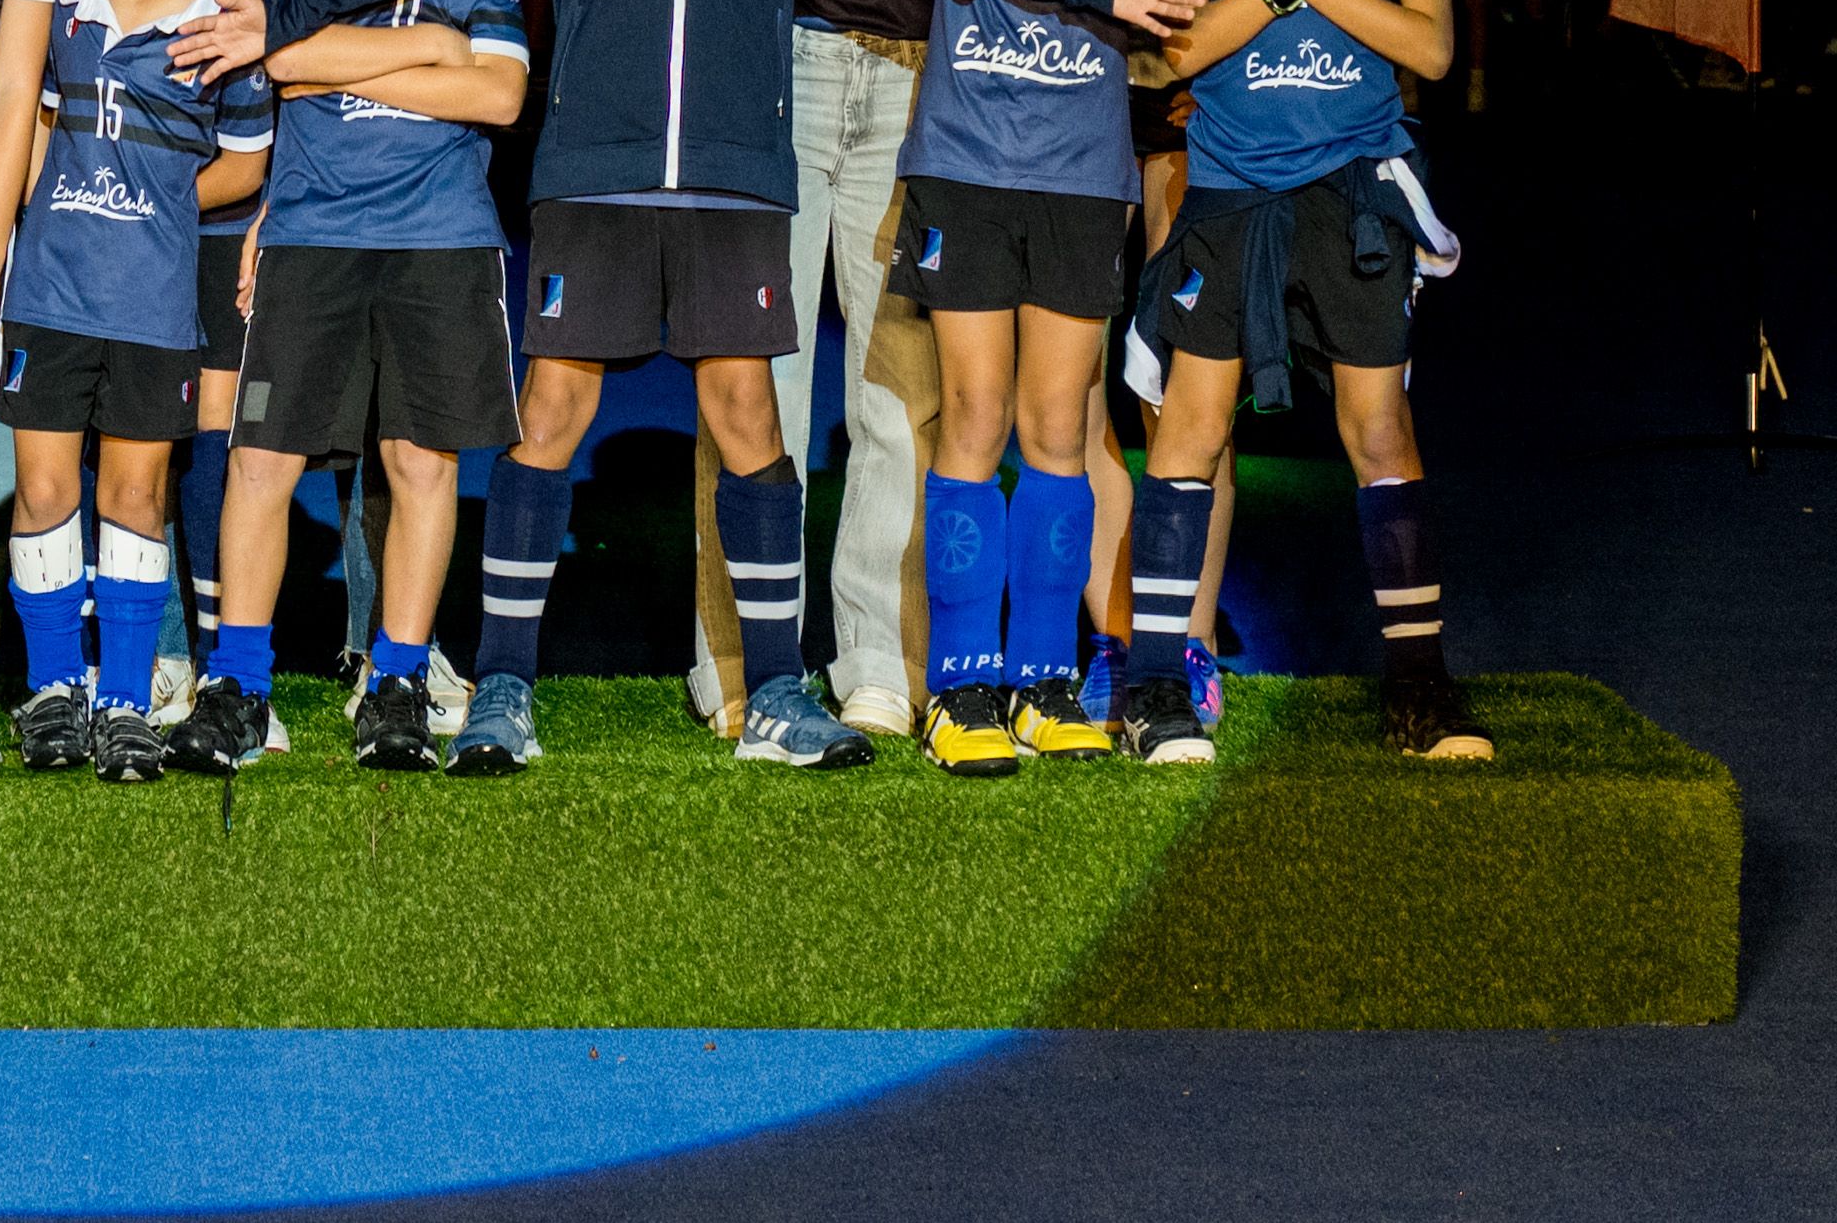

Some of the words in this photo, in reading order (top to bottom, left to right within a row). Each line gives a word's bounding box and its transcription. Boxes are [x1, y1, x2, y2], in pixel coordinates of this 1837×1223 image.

[954, 24, 1041, 78] Enjoy
[1039, 39, 1105, 77] Cuba
[1245, 51, 1315, 88] Enjoy
[1315, 52, 1363, 82] Cuba
[95, 77, 126, 141] 15
[50, 173, 109, 211] Enjoy
[108, 182, 156, 216] Cuba
[941, 652, 1005, 673] KIPS
